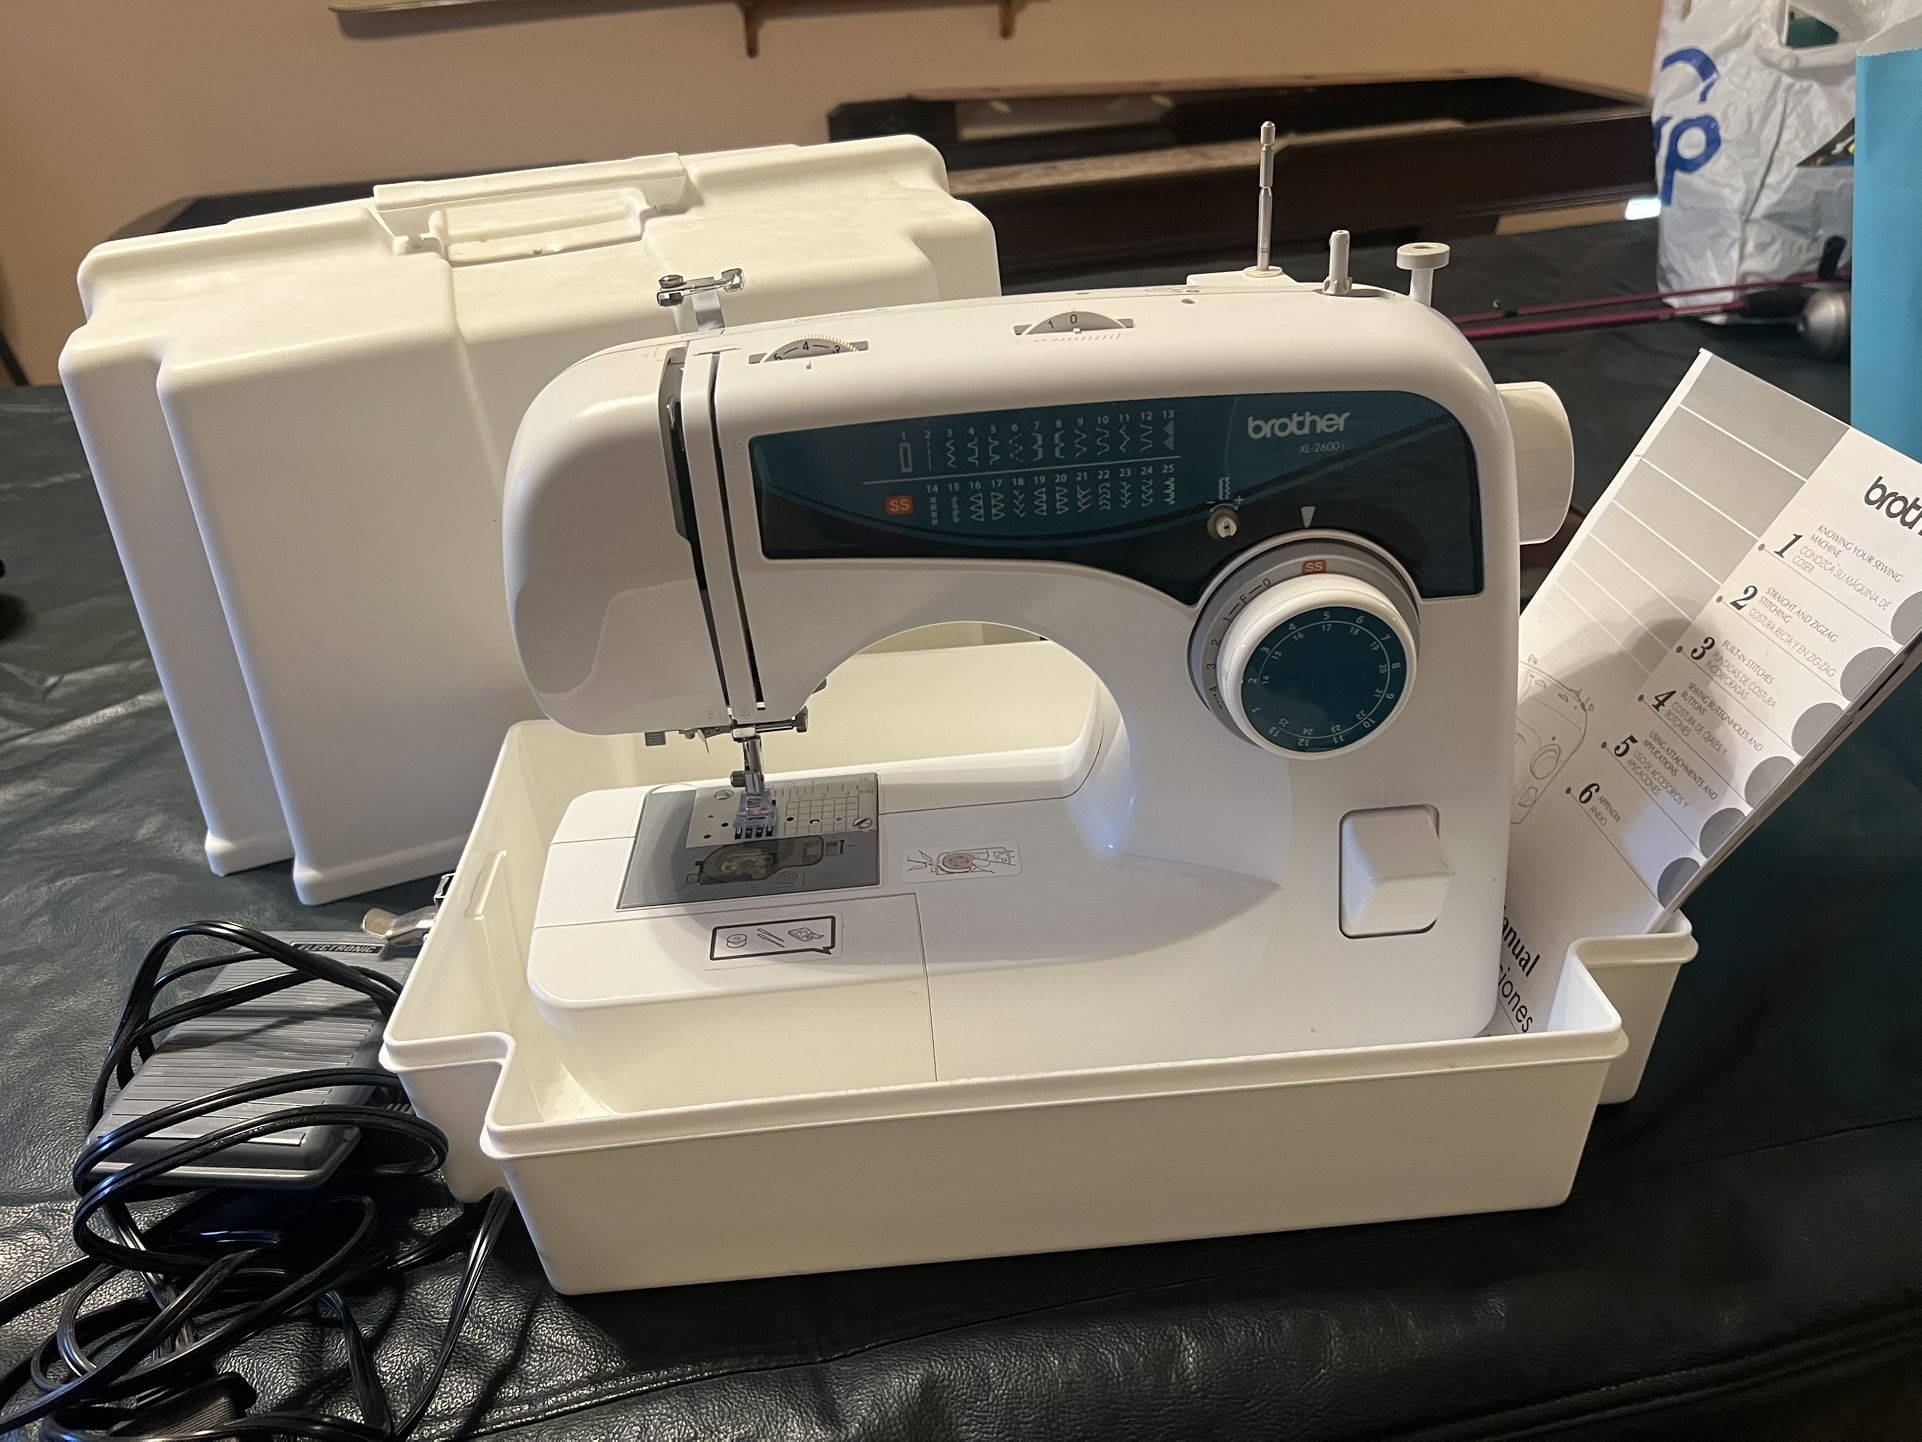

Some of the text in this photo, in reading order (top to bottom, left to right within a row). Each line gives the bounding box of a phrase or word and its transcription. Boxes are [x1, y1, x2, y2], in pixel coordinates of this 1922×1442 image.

[1070, 314, 1078, 324] 0
[802, 340, 810, 351] 4
[901, 410, 1174, 440] 1 2 3 4 5 6 7 8 9 10 11 12 13
[1247, 411, 1350, 439] brother
[890, 464, 1174, 512] SS 14 15 16 17 18 19 20 21 22 23 24 25
[1864, 476, 1922, 536] brot
[1774, 533, 1803, 558] 1
[1810, 534, 1842, 559] MACHINE
[1817, 524, 1904, 583] KNOWING YOUR SEWING
[1240, 593, 1248, 603] F
[1305, 562, 1322, 572] SS
[1800, 546, 1836, 574] CONOZCA
[1878, 598, 1891, 611] DE
[1730, 585, 1758, 610] 2
[1758, 596, 1792, 624] STITCHING
[1765, 587, 1839, 643] STRAIGHT AND ZIGZAG
[1690, 636, 1715, 660] 3
[1745, 659, 1774, 685] STITCHES
[1652, 690, 1677, 712] 4
[1614, 734, 1639, 758] 5
[1579, 783, 1600, 804] 6
[1702, 784, 1718, 800] AND
[298, 944, 377, 953] ELECTRONIC
[1502, 905, 1540, 977] anual
[1498, 964, 1533, 1033] iones
